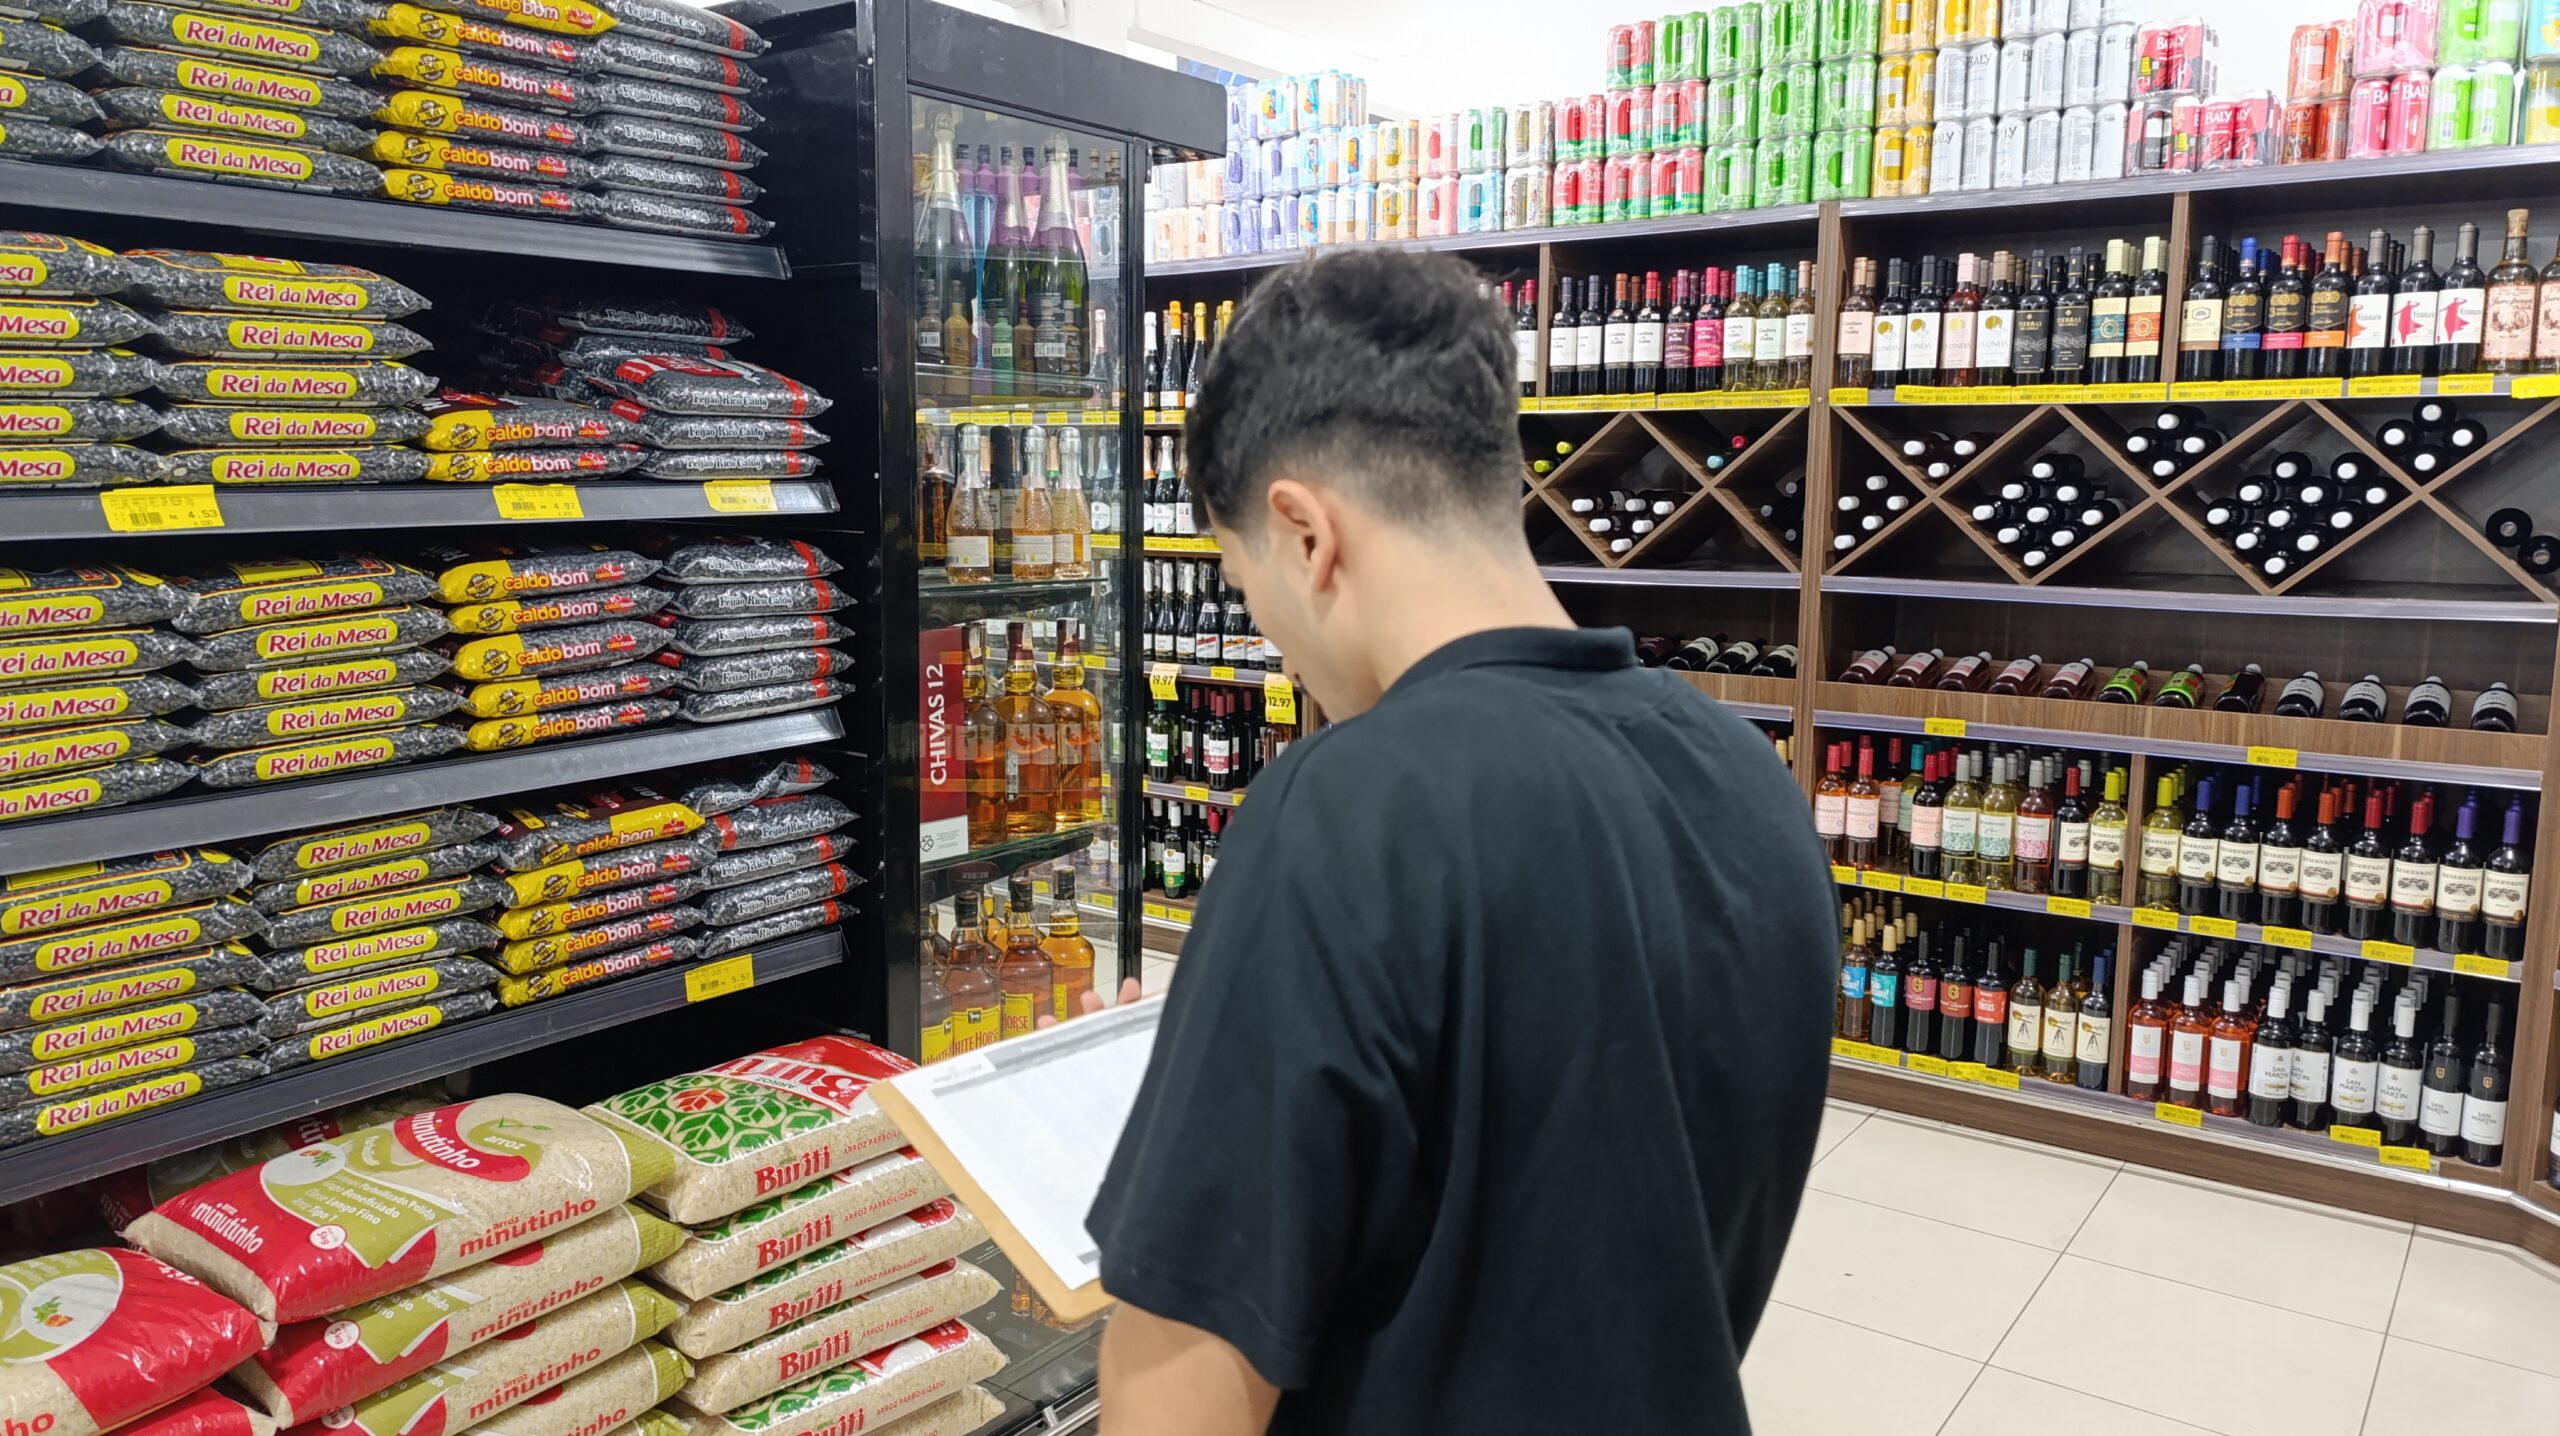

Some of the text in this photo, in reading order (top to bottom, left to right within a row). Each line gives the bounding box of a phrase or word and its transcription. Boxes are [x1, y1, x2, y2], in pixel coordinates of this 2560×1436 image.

[186, 20, 310, 58] Rei da Mesa
[453, 22, 542, 53] caldobom
[190, 66, 311, 103] Rei da Mesa
[452, 65, 540, 95] caldobom
[177, 99, 296, 135] Rei da Mesa
[453, 110, 540, 138] caldobom
[2204, 109, 2233, 125] BALY
[181, 142, 303, 176] Rei da Mesa
[440, 146, 531, 173] caldobom
[443, 182, 535, 207] caldobom
[237, 281, 358, 307] Rei da Mesa
[242, 325, 364, 349] Rei da Mesa
[221, 374, 348, 395] Rei da Mesa
[244, 416, 366, 437] Rei da Mesa
[485, 422, 574, 443] caldobom
[225, 459, 351, 479] Rei da Mesa
[483, 452, 572, 475] caldobom
[502, 571, 589, 592] caldobom
[255, 591, 374, 617] Rei da Mesa
[511, 601, 598, 625] caldobom
[269, 627, 389, 653] Rei da Mesa
[516, 640, 601, 667] caldobom
[270, 667, 387, 694] Rei da Mesa
[532, 682, 617, 708] caldobom
[531, 713, 612, 739] caldobom
[926, 663, 948, 785] CHIVAS 12
[270, 746, 386, 775] Rei da Mesa
[310, 832, 422, 863] Rei da Mesa
[576, 828, 655, 855] caldobom
[576, 860, 656, 889] caldobom
[18, 890, 160, 929] Rei da Mesa
[344, 898, 452, 929] Rei da Mesa
[561, 894, 643, 925] caldobom
[51, 929, 190, 966] Rei da Mesa
[564, 921, 642, 953] caldobom
[560, 953, 640, 986] caldobom
[319, 1014, 430, 1053] Rei da Mesa
[49, 1081, 187, 1128] Rei da Mesa
[411, 1111, 481, 1169] minutinho
[483, 1134, 528, 1150] arroz
[843, 1141, 868, 1155] ARROZ
[754, 1145, 831, 1197] Buriti
[307, 1205, 330, 1221] Tipo
[325, 1198, 382, 1226] Longo Fino
[341, 1188, 401, 1219] Beneficiado
[844, 1187, 919, 1223] ARROZ PARBOILIZADO
[191, 1202, 264, 1254] minutinho
[459, 1198, 597, 1258] minutinho
[493, 1216, 521, 1231] arroz
[756, 1214, 833, 1271] Buriti
[854, 1273, 879, 1288] ARROZ
[422, 1292, 450, 1312] Polido
[471, 1275, 604, 1342] minutinho
[768, 1279, 843, 1331] Buriti
[861, 1325, 885, 1339] ARROZ
[778, 1329, 850, 1382] Buriti
[469, 1348, 601, 1419] minutinho
[876, 1403, 899, 1417] ARROZ
